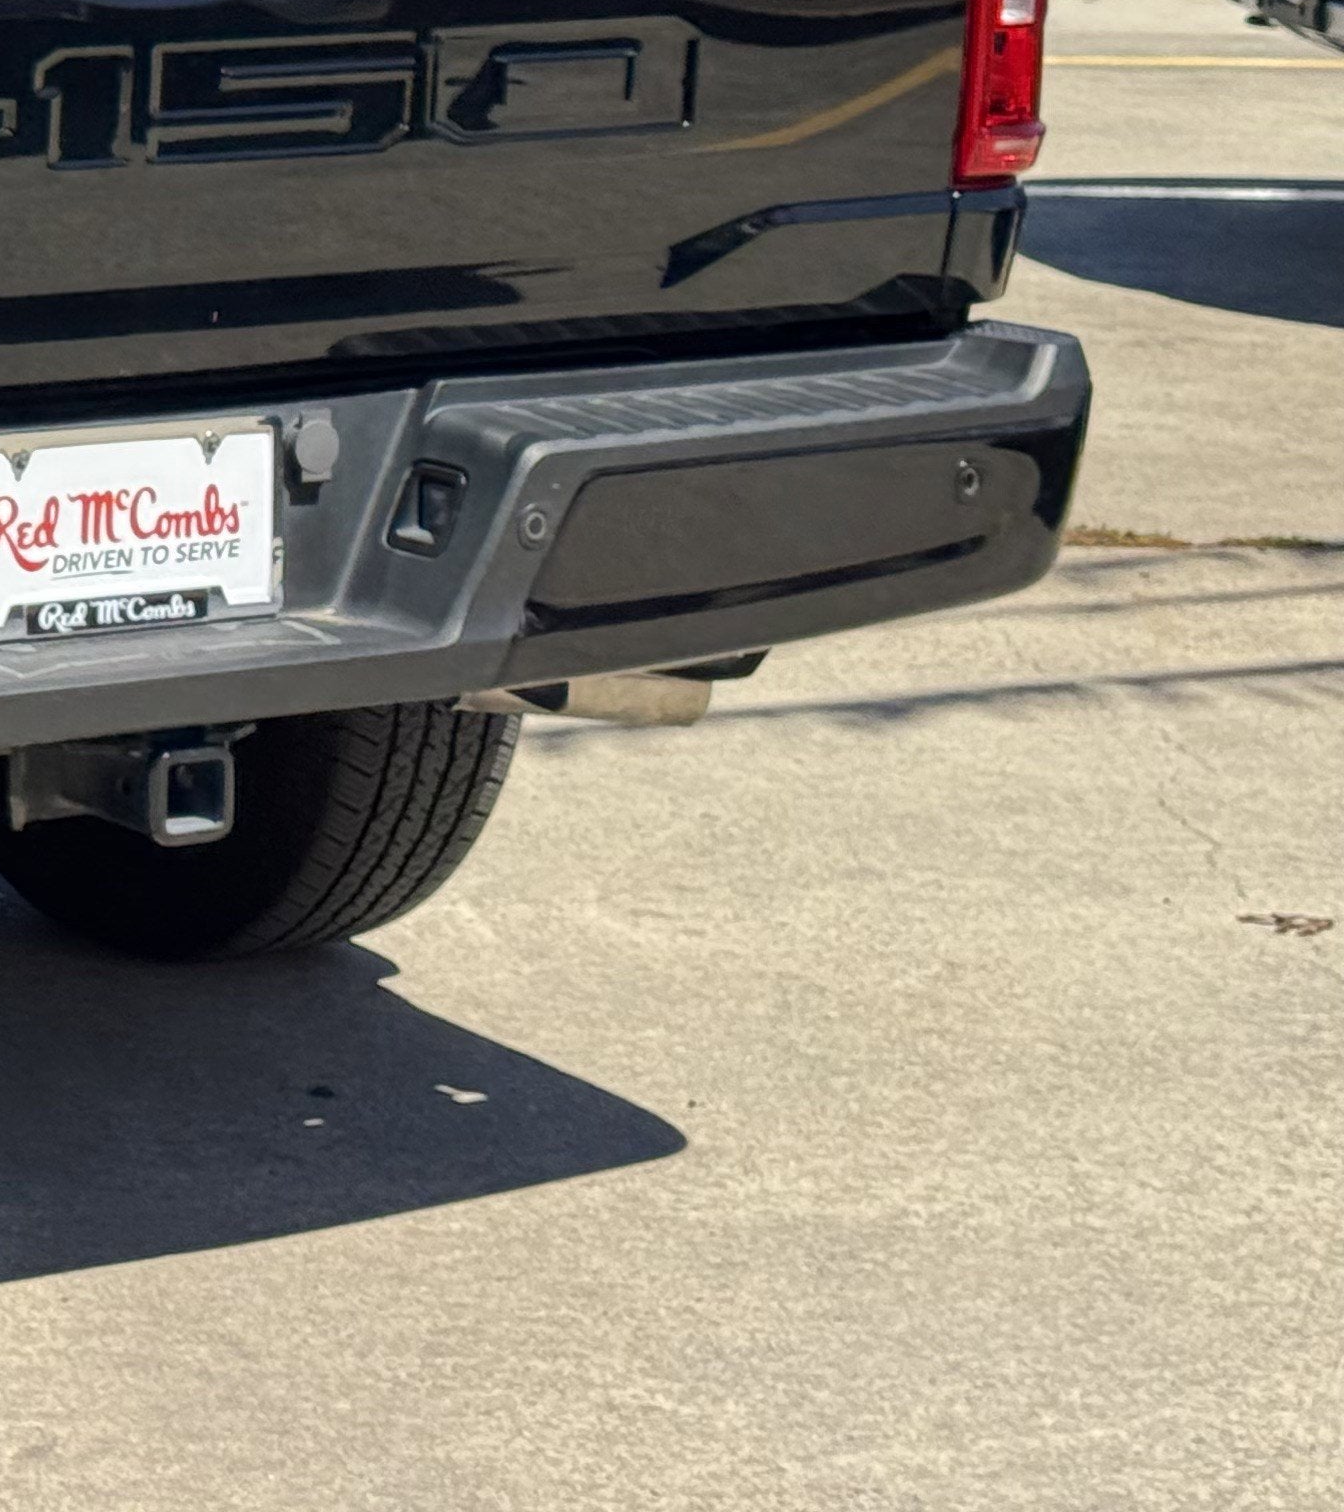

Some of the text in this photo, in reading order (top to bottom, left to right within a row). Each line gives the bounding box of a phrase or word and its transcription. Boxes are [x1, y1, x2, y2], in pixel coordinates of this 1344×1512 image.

[68, 484, 240, 545] McCombs
[52, 538, 240, 575] DRIVEN TO SERVE
[38, 594, 196, 633] Red McCombs
